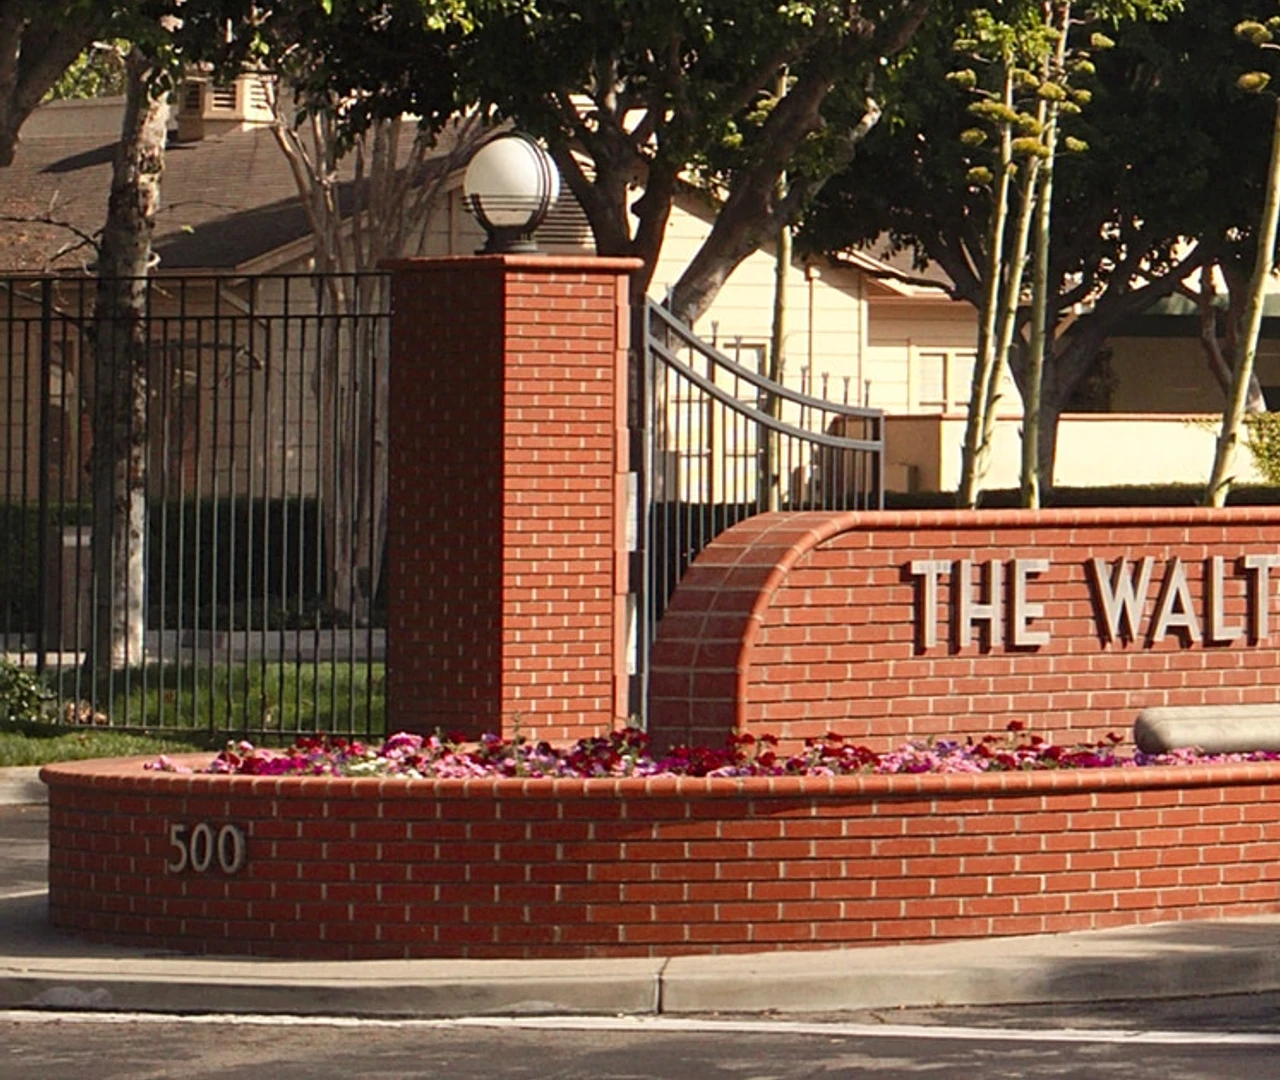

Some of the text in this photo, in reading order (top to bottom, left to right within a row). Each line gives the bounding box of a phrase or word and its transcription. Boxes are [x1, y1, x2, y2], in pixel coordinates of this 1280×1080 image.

[908, 558, 1049, 653] THE
[1087, 553, 1280, 648] WALT
[169, 823, 244, 873] 500
